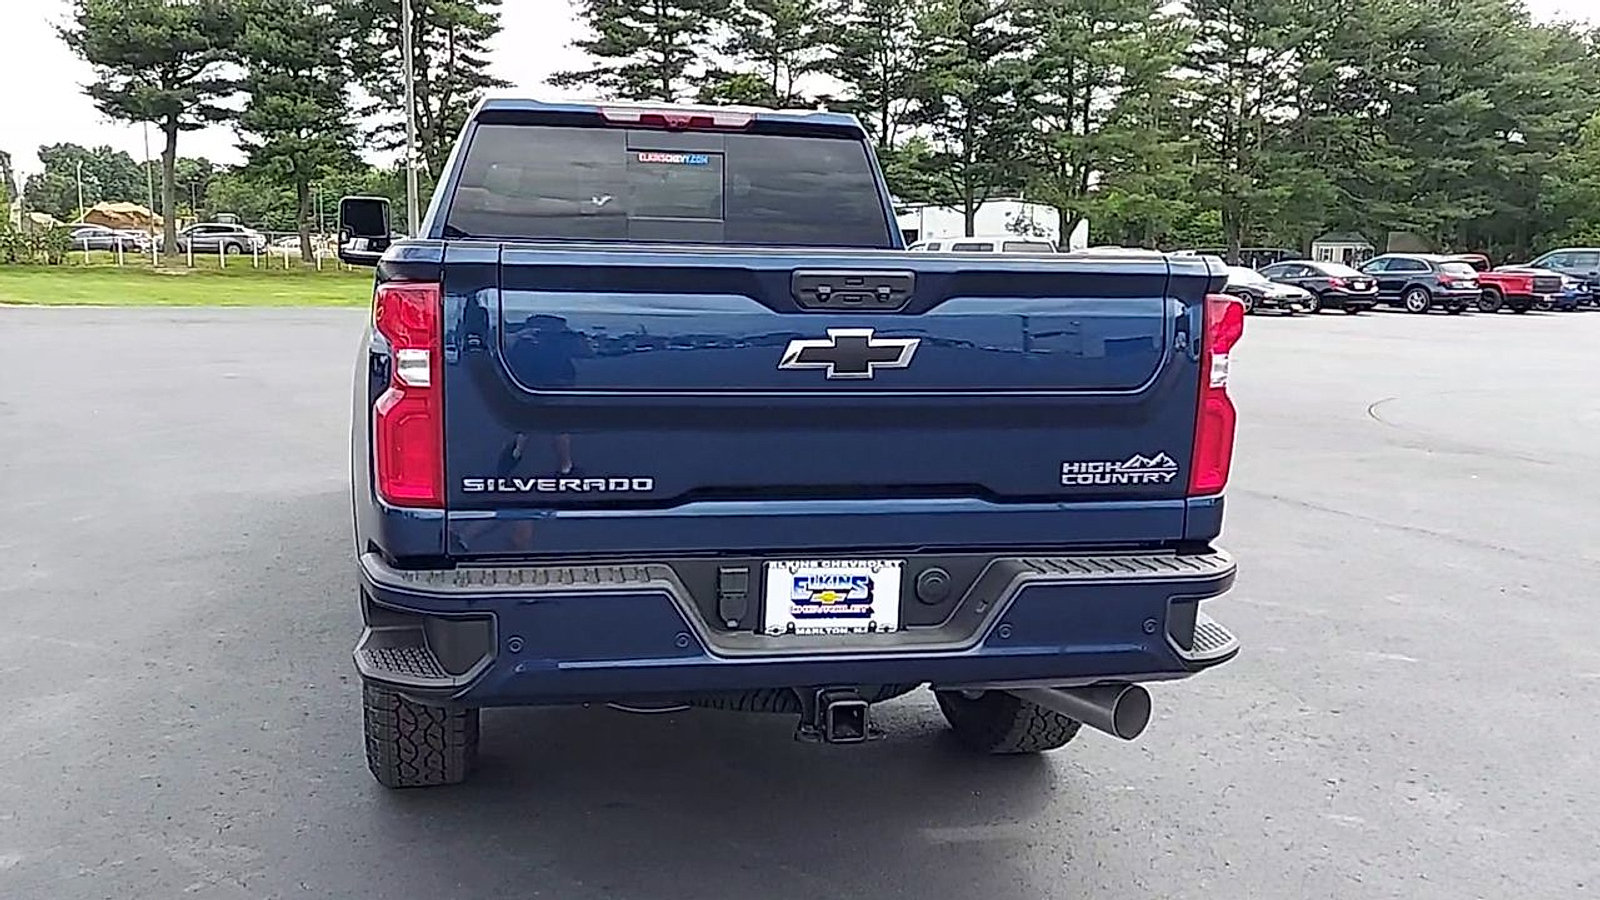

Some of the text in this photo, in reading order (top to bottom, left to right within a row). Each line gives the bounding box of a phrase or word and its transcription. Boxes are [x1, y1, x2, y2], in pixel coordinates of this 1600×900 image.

[1062, 462, 1121, 473] HIGH
[1062, 472, 1177, 484] COUNTRY
[463, 478, 653, 492] SILVERADO
[769, 560, 902, 569] ELKINS CHEVROLET
[791, 574, 873, 601] ELKINS
